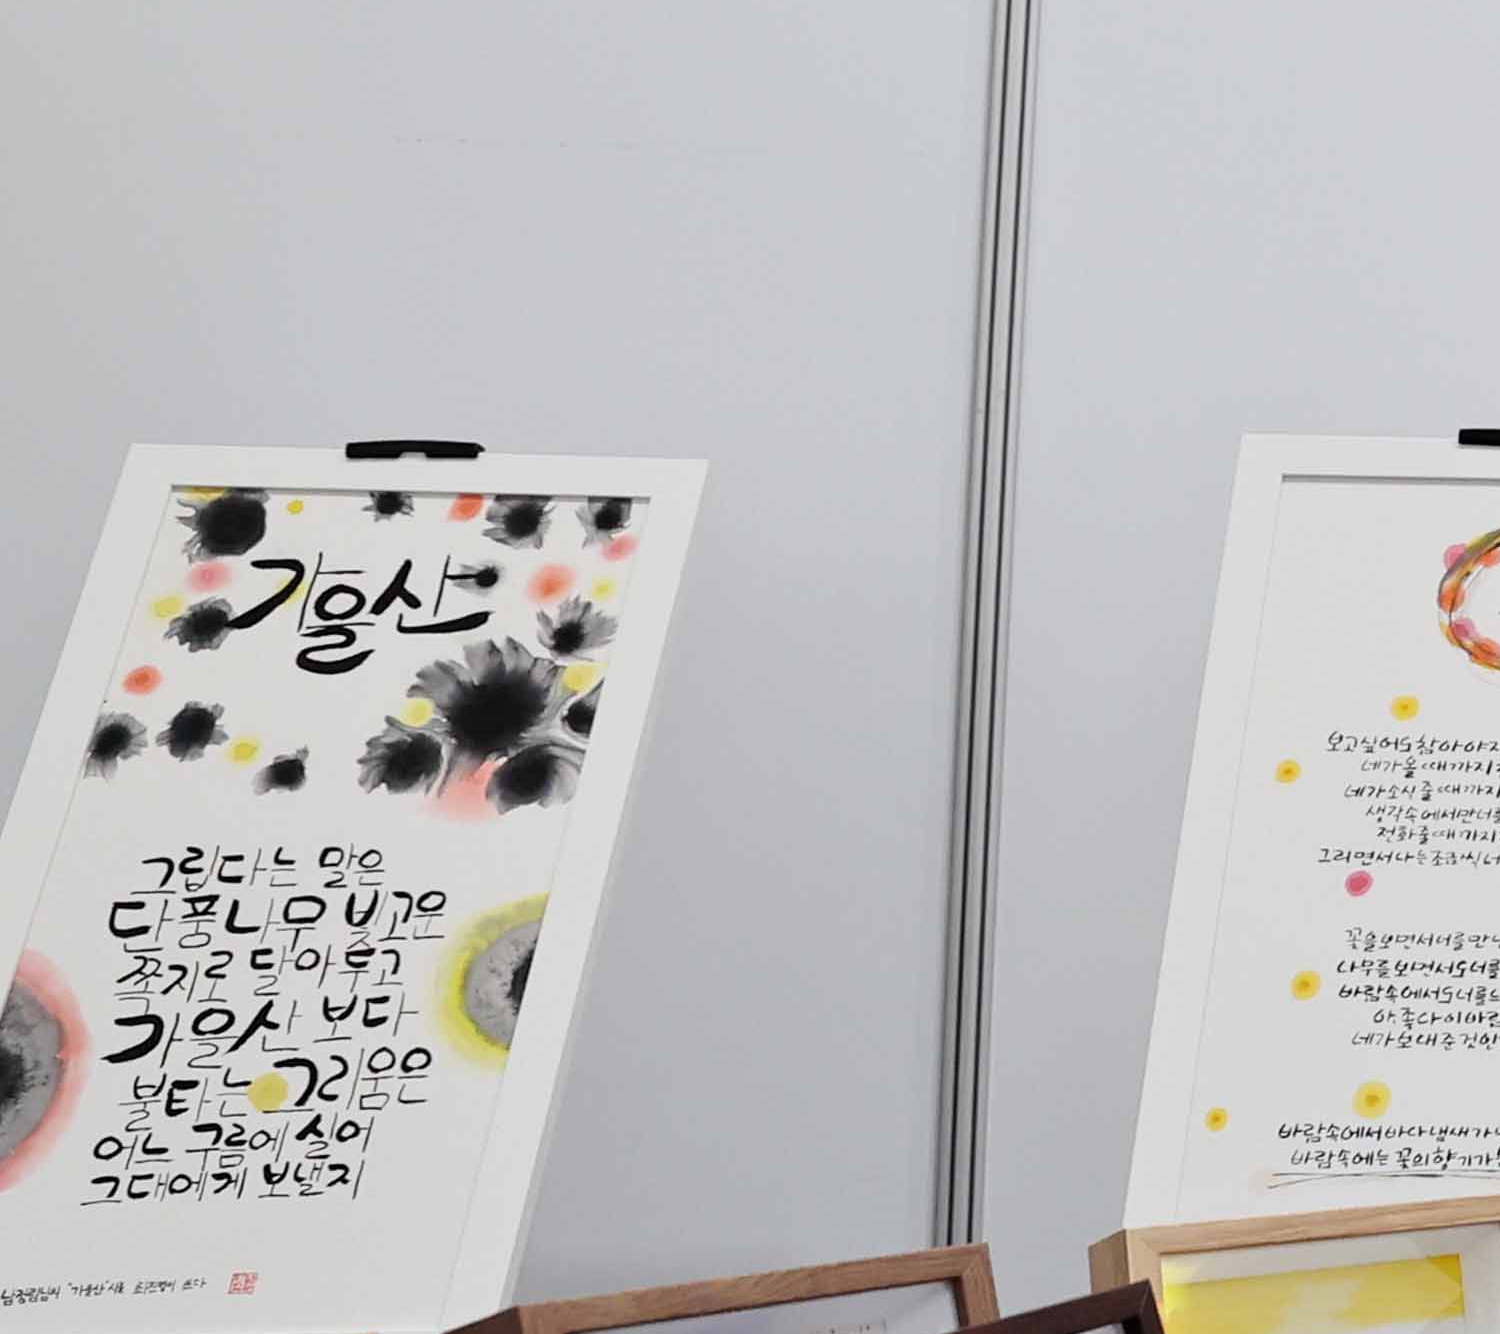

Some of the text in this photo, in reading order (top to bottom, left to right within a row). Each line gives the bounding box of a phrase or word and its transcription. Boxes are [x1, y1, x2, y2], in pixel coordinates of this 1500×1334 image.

[226, 552, 497, 675] 가을산
[130, 842, 385, 895] 그립다는 말은
[108, 894, 327, 954] 단풍나무
[113, 950, 234, 1017] 쪽지로
[100, 993, 420, 1069] 가을산 보다
[117, 1046, 433, 1132] 불타는 그리움은
[93, 1113, 375, 1173] 어느 구름에 실어
[80, 1159, 365, 1206] 그대에게 보낼지
